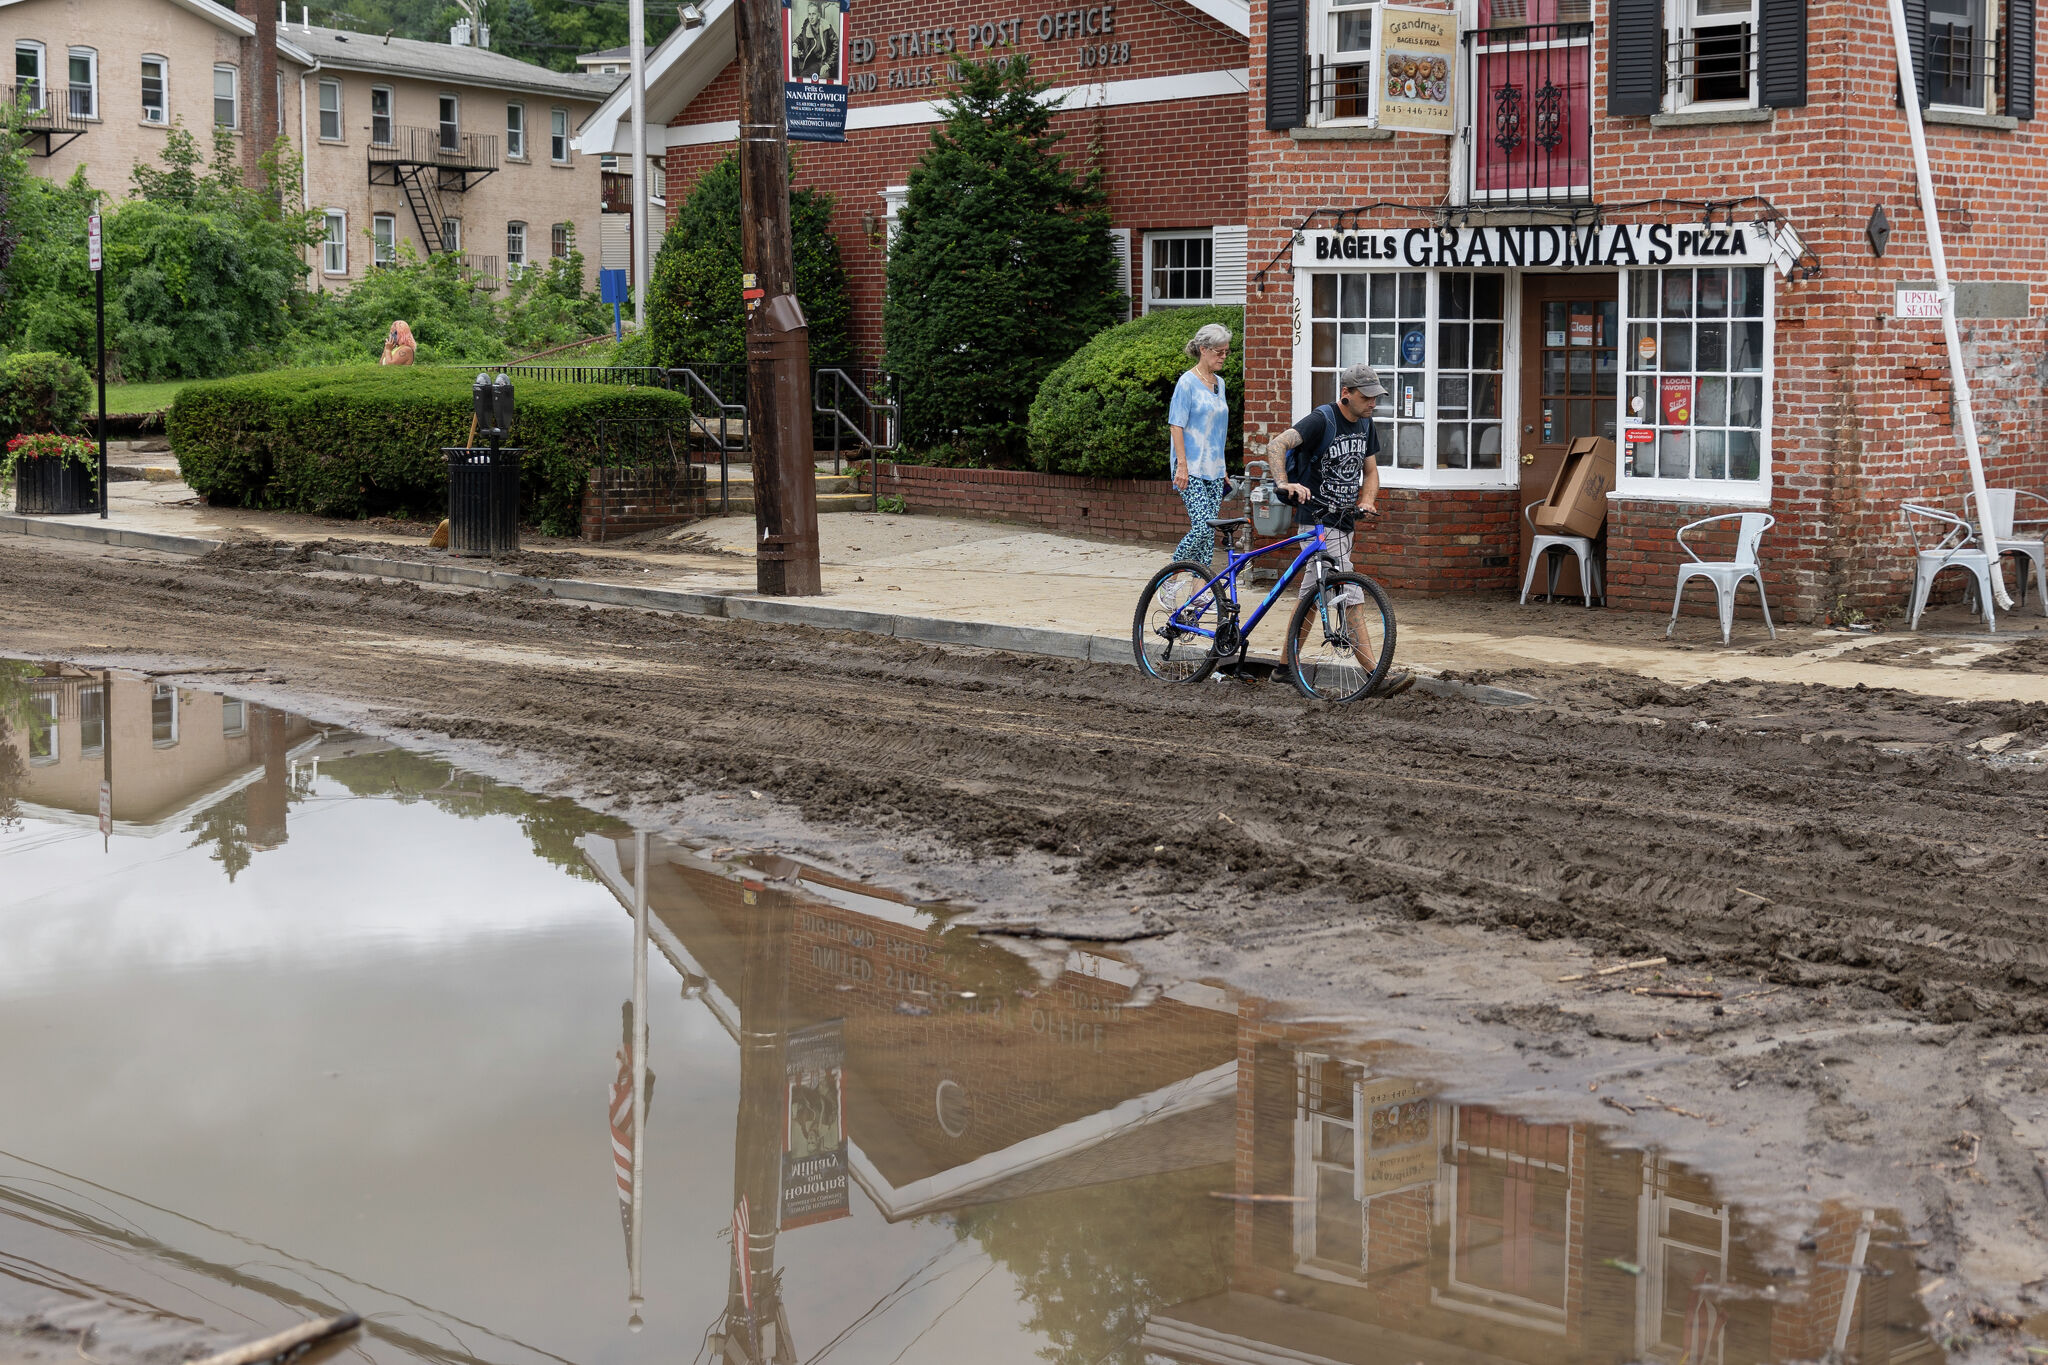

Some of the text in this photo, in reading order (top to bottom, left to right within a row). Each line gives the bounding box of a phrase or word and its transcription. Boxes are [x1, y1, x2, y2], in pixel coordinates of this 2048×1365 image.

[888, 27, 957, 59] STATES
[968, 18, 1023, 49] POST
[1037, 6, 1115, 41] OFFICE
[1389, 17, 1445, 36] Grandma's
[1397, 36, 1419, 45] BAGELS
[1079, 42, 1131, 68] 10928
[786, 91, 846, 102] NANARTOWICH
[1385, 105, 1449, 117] 845-446-7542
[1316, 223, 1747, 267] BAGELS GRANDMA'S PIZZA
[1905, 292, 1942, 304] UPSTAI
[1294, 297, 1302, 346] 265
[1571, 321, 1600, 333] Close
